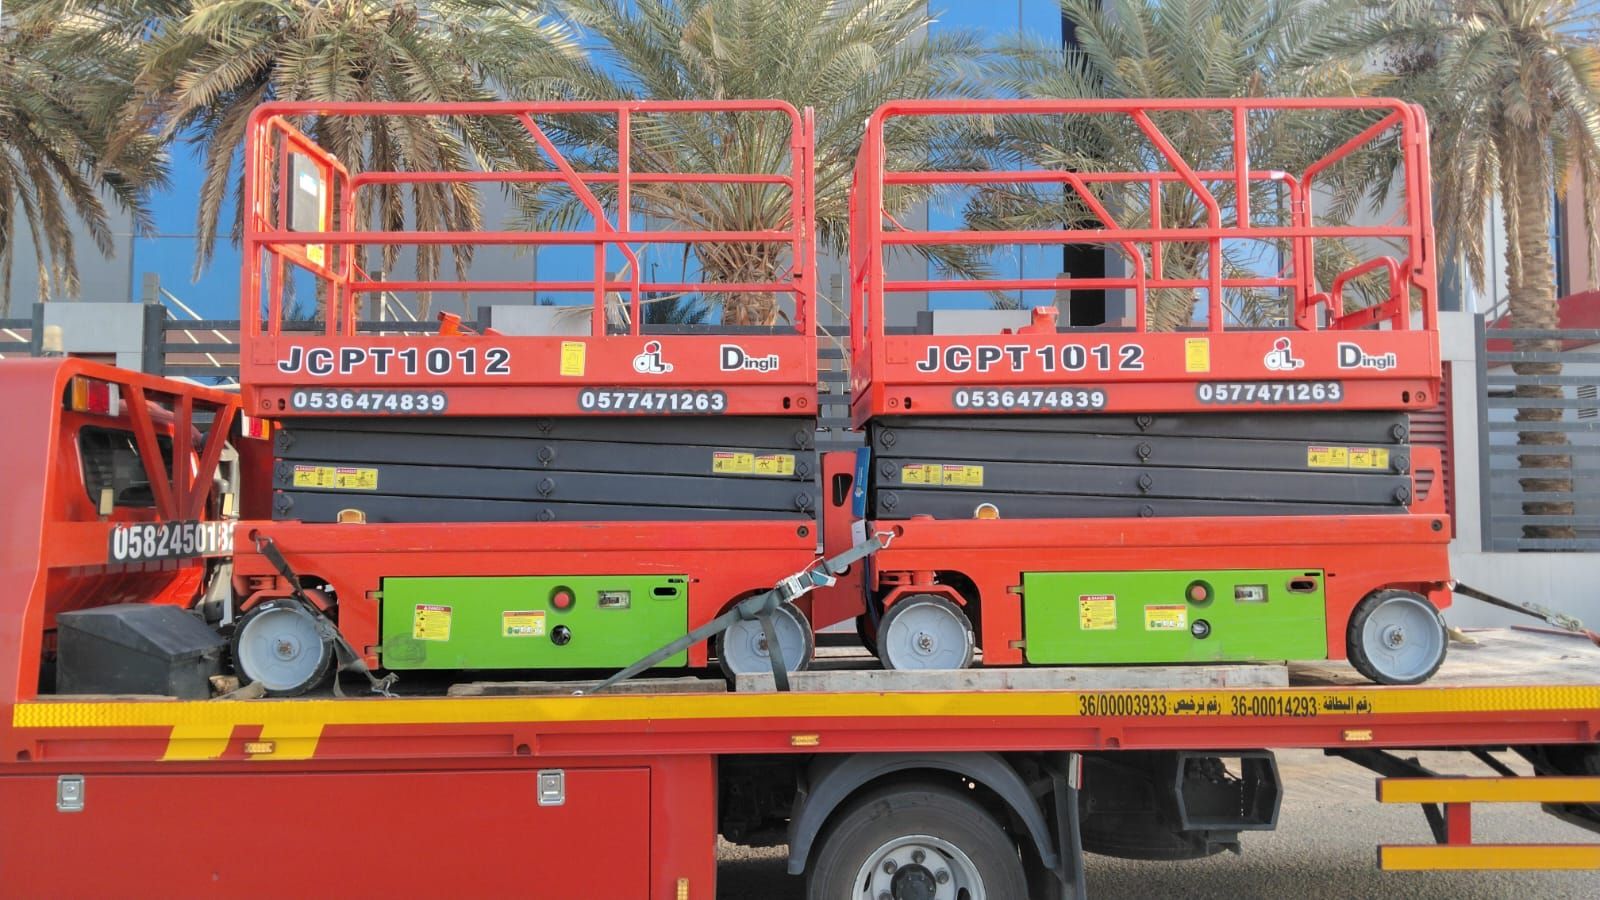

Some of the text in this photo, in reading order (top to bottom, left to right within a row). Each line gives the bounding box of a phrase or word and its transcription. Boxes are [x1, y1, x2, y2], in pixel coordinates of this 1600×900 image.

[278, 346, 511, 376] JCPT1012
[720, 344, 779, 373] Dingli
[916, 343, 1145, 372] JCPT1012
[1338, 341, 1397, 369] Dingli
[293, 391, 445, 411] 0536474839
[581, 391, 724, 410] 0577471263
[955, 390, 1105, 408] 0536474839
[1199, 382, 1340, 401] 0577471263
[1079, 694, 1167, 716] 36/00003933
[1206, 695, 1222, 715] رقم
[1231, 695, 1317, 717] 36-00014293
[1356, 695, 1372, 715] رقم
